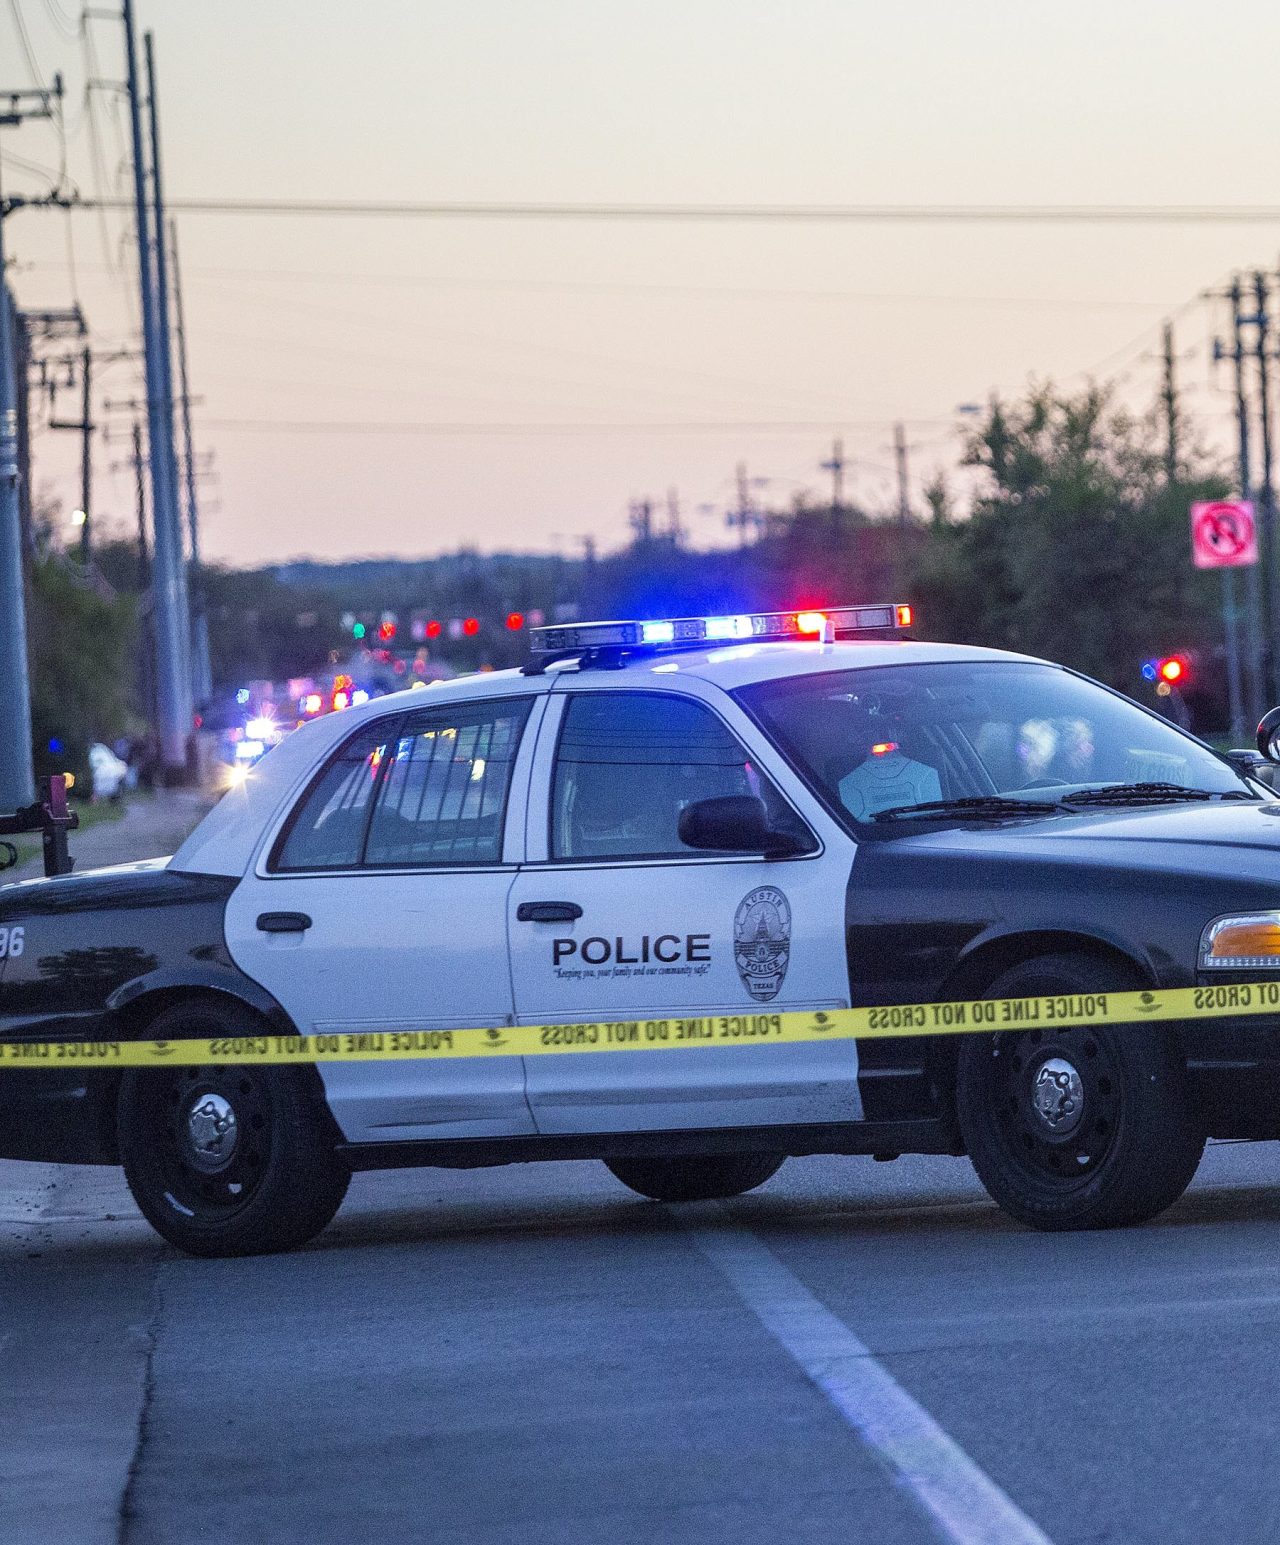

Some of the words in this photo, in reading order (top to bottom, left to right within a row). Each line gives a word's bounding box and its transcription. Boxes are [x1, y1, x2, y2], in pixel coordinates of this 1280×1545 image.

[745, 892, 783, 910] AUSTIN
[553, 934, 711, 966] POLICE
[633, 966, 646, 976] and
[658, 964, 693, 977] community
[745, 959, 780, 973] POLICE
